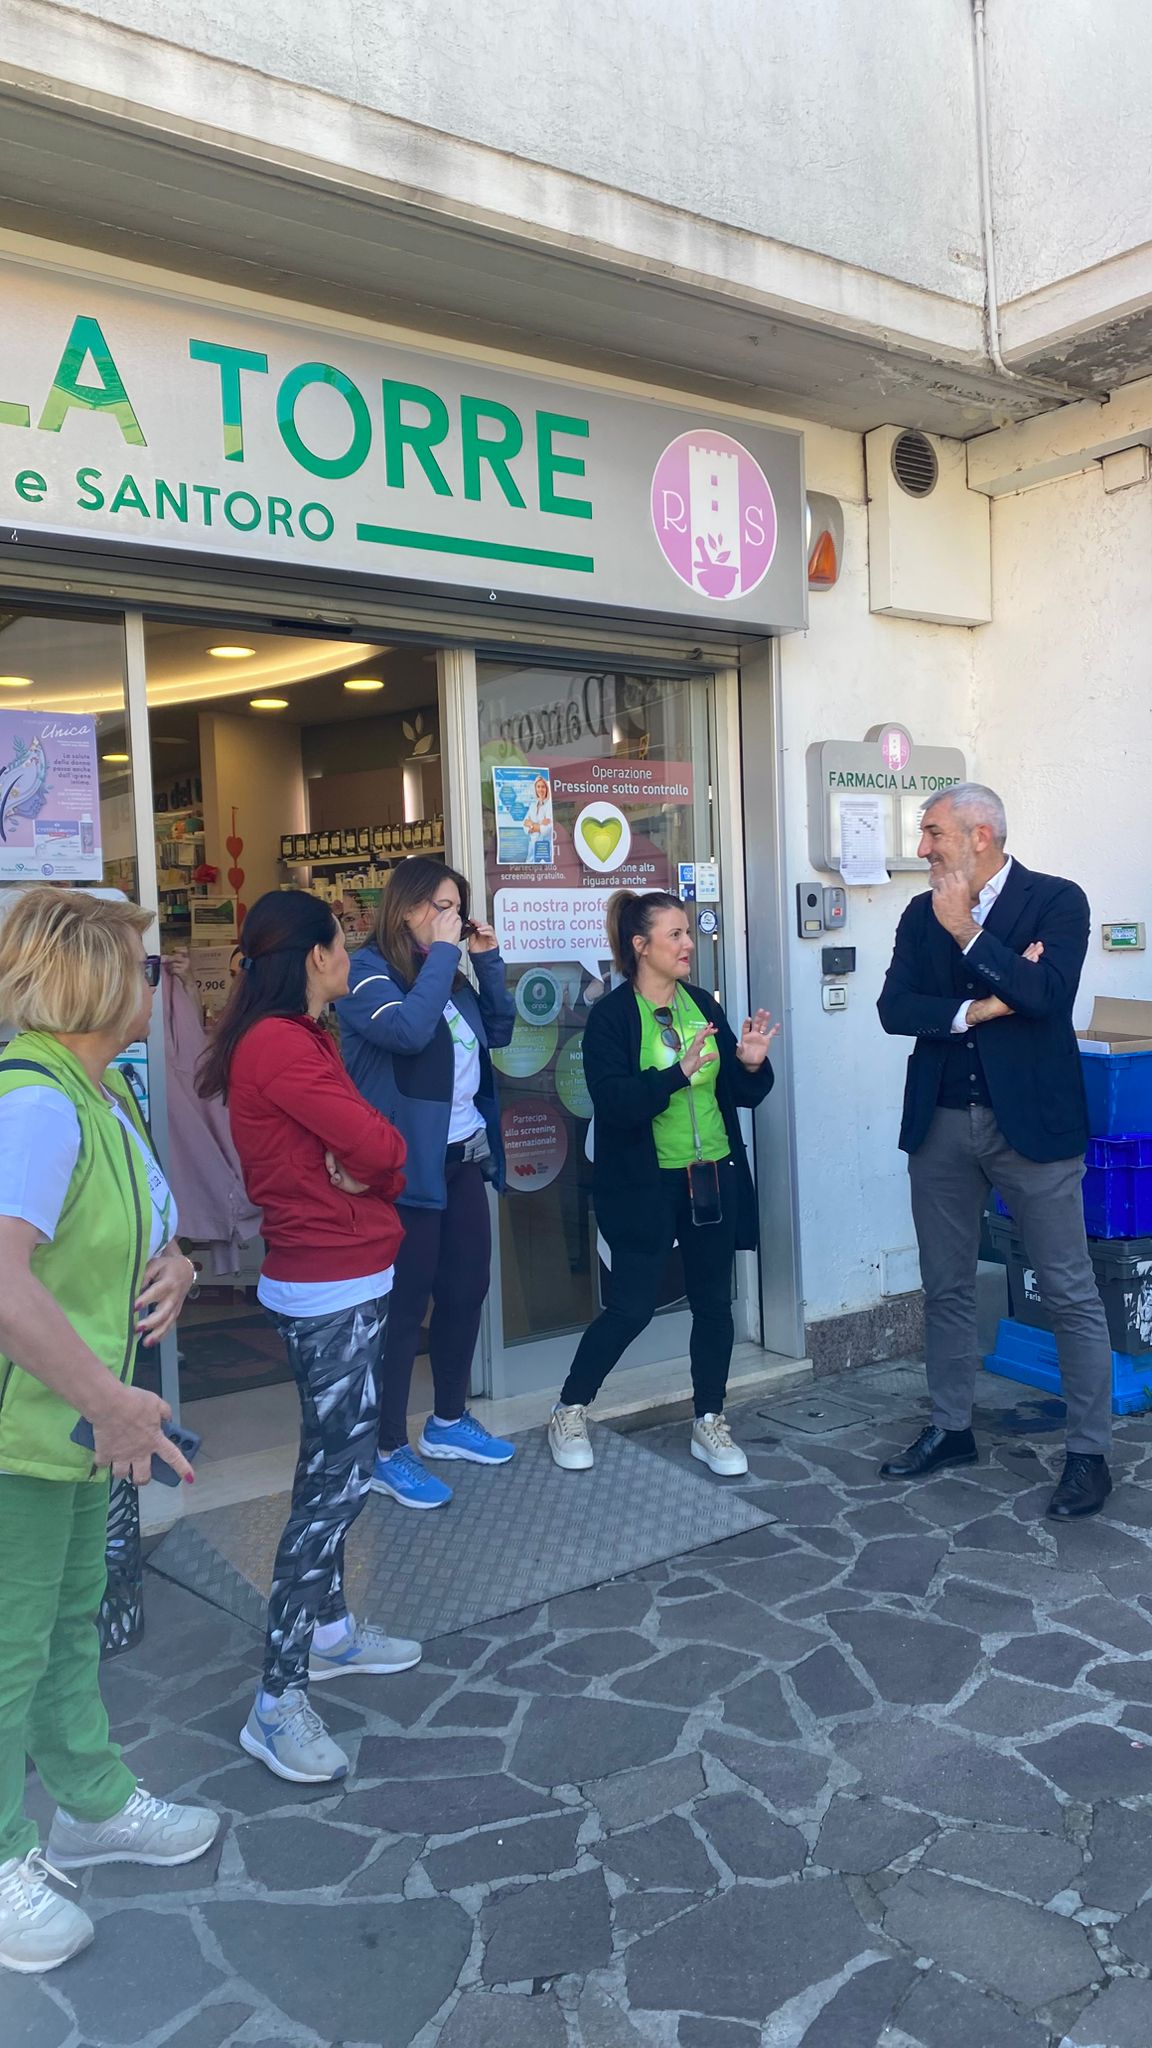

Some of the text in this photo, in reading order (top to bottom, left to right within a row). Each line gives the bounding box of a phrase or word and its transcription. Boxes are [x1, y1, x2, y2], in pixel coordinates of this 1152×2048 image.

[189, 338, 595, 520] TORRE
[14, 466, 336, 543] e SANTORO
[661, 496, 767, 547] R S
[41, 722, 91, 739] Unica
[592, 766, 652, 780] Operazione
[829, 771, 898, 790] FARMACIA
[902, 775, 918, 790] LA
[553, 780, 689, 796] Pressione sotto controllo
[639, 862, 656, 872] alta
[501, 872, 566, 882] screening gratuito.
[582, 875, 647, 887] riguarda anche
[503, 898, 609, 916] La nostra profe
[503, 918, 516, 932] la
[519, 919, 566, 932] nostra
[504, 934, 609, 950] al vostro serviz
[512, 1113, 548, 1124] Partecipa
[504, 1125, 557, 1137] allo screening
[504, 1136, 557, 1149] internazionale
